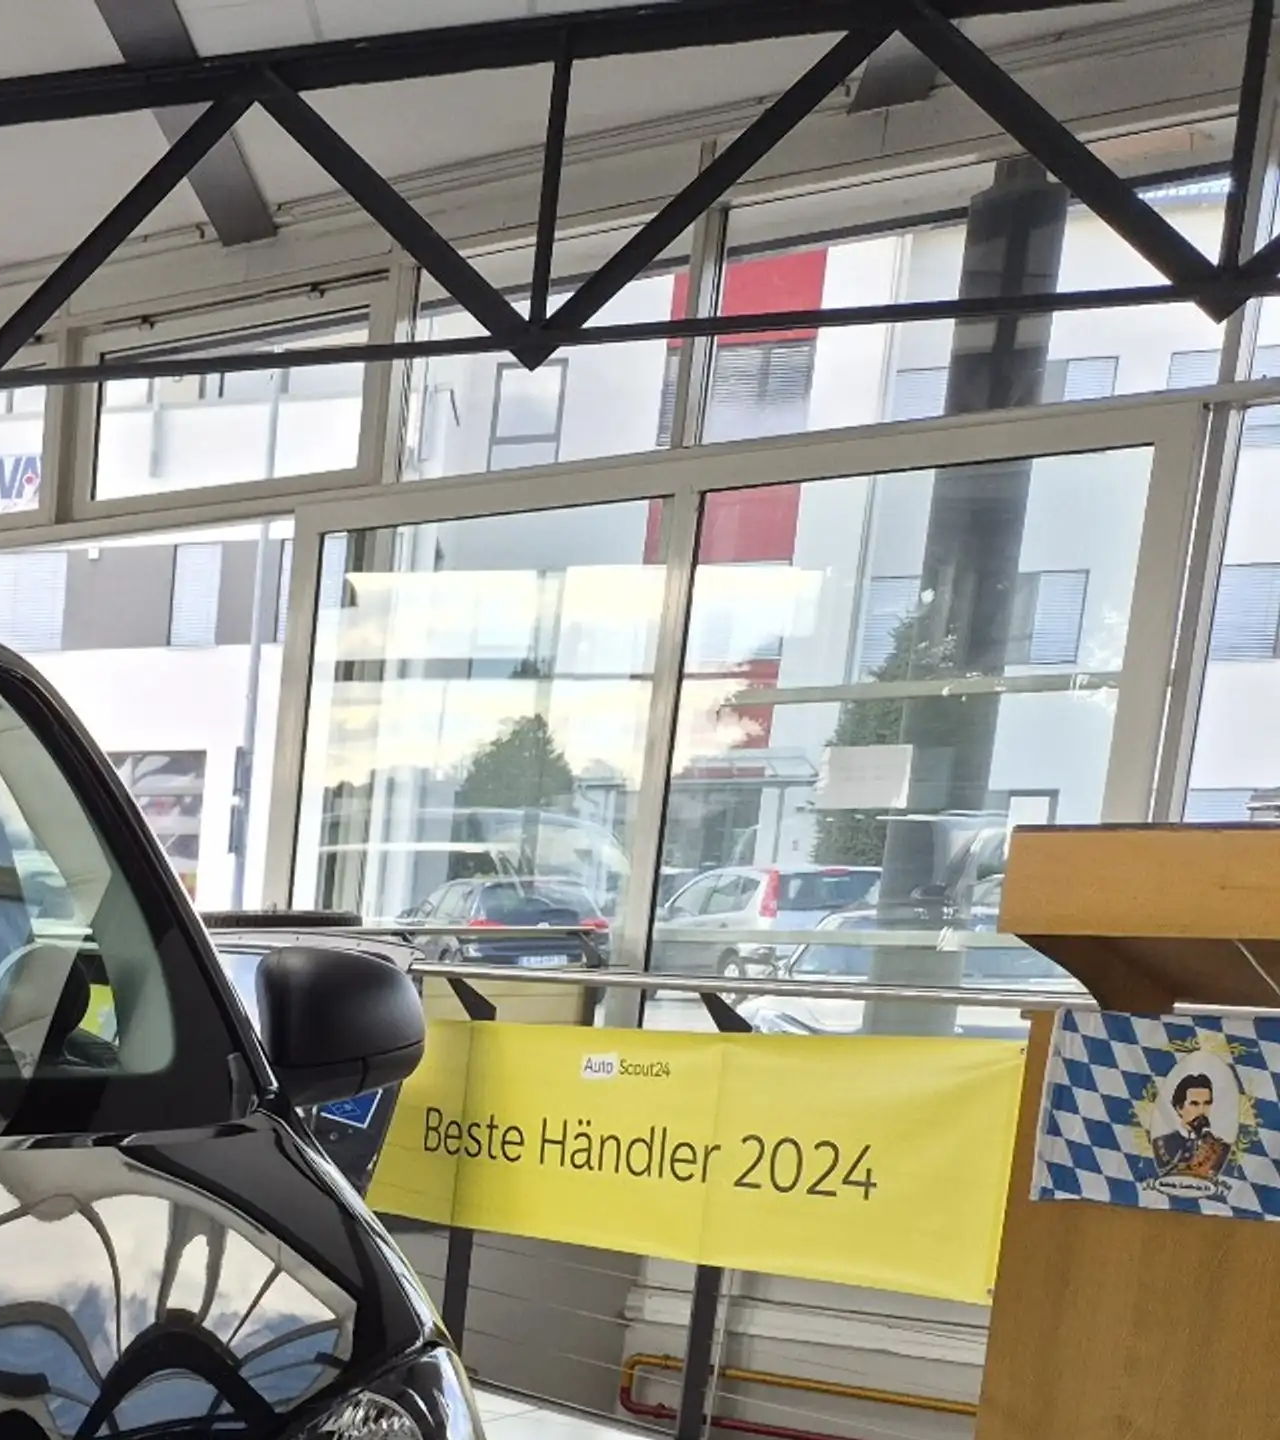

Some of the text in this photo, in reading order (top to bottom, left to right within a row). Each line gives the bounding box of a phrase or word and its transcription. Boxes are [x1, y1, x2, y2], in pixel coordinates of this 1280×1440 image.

[584, 1057, 671, 1078] Auto Scout24
[424, 1106, 877, 1201] Beste Händler 2024
